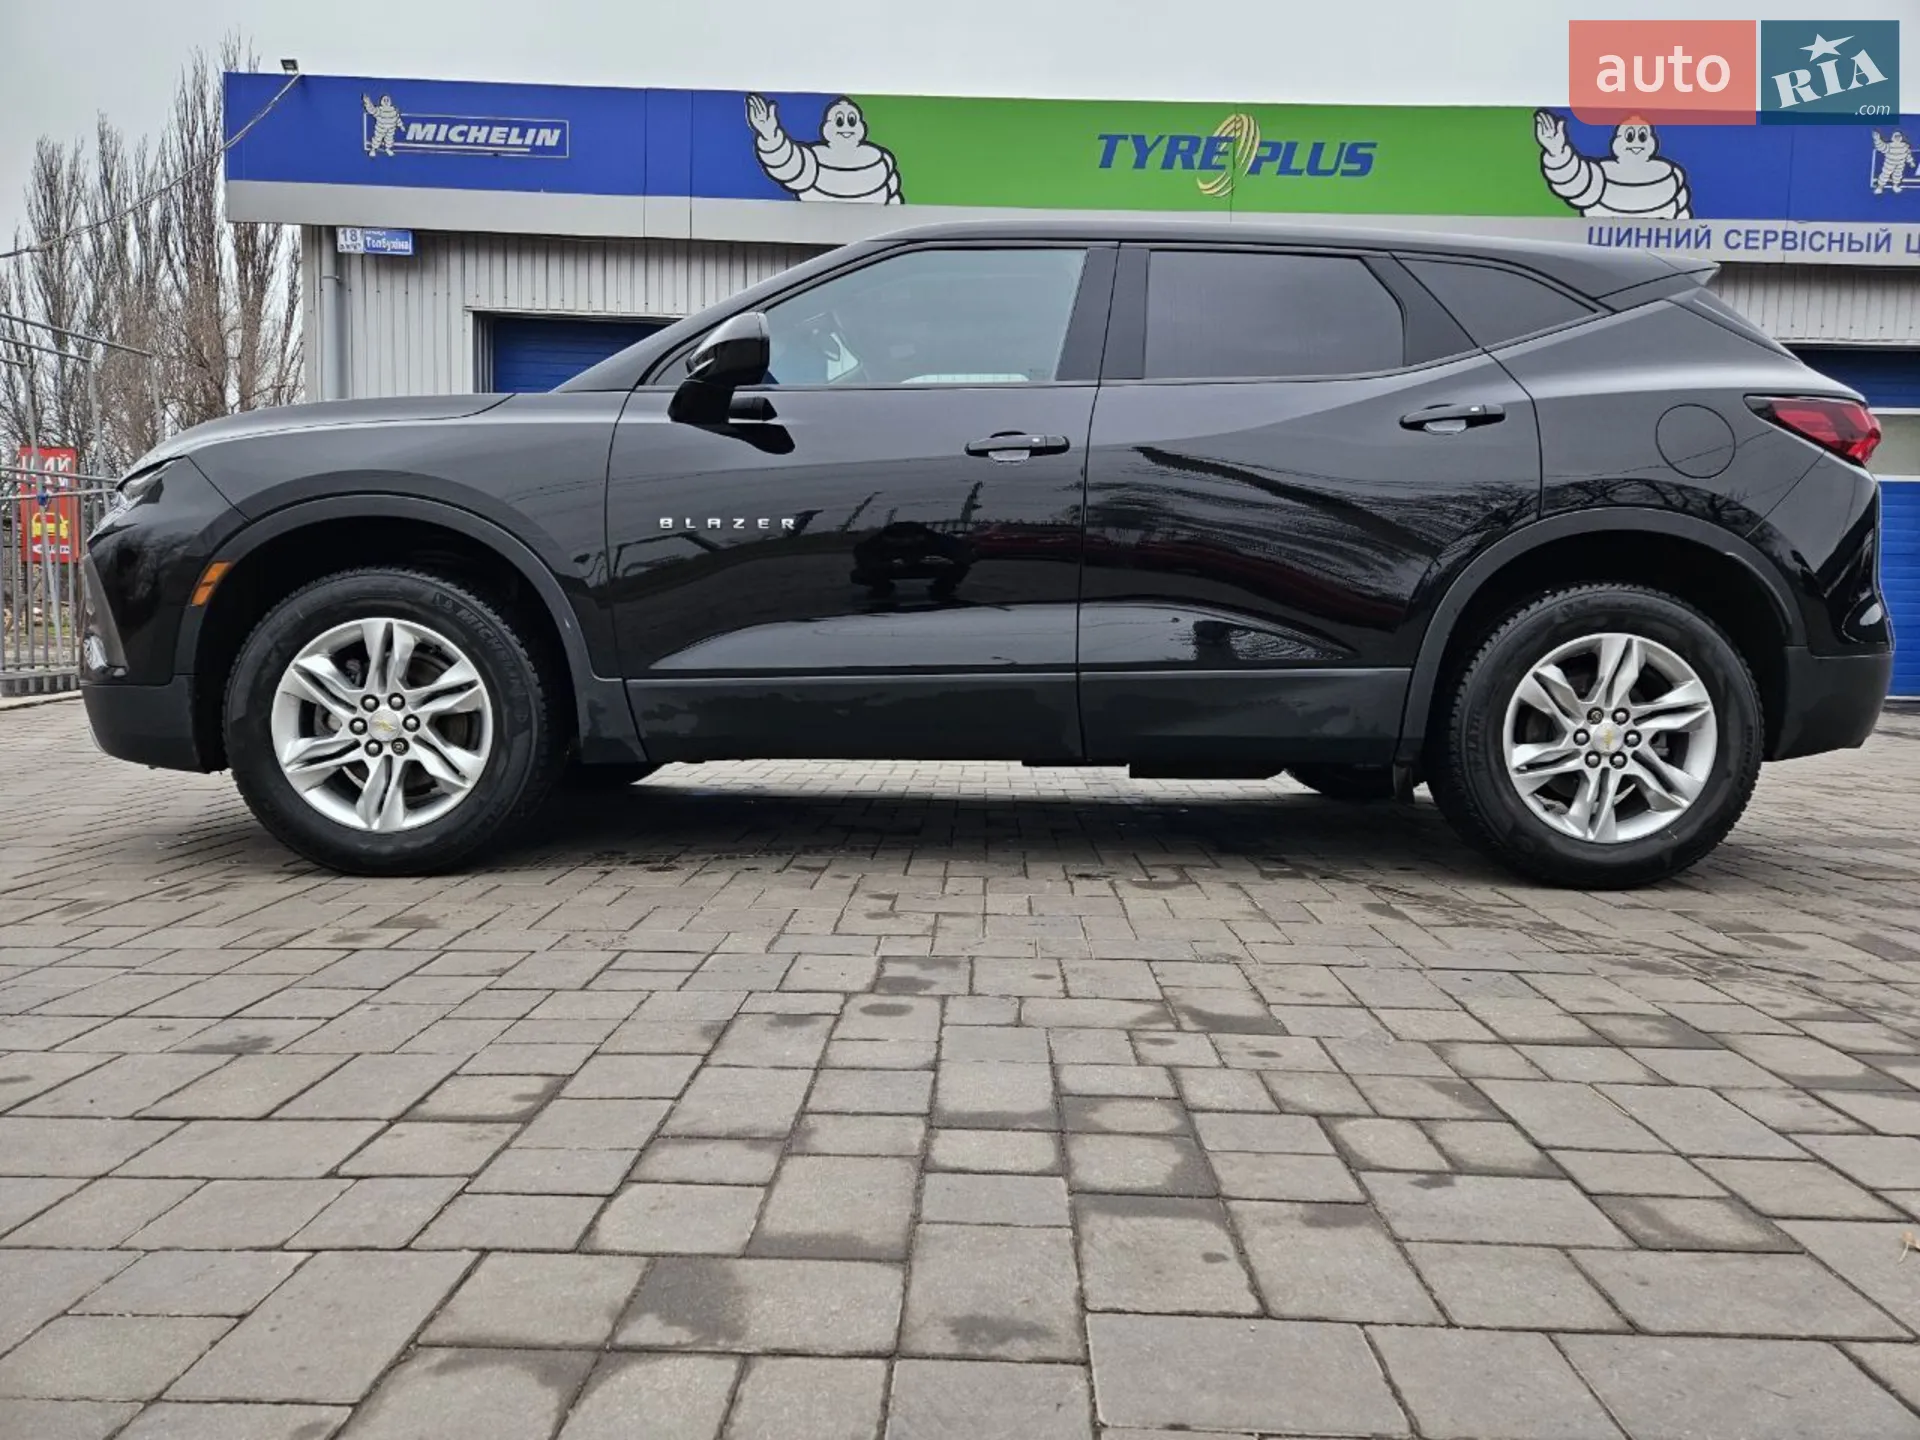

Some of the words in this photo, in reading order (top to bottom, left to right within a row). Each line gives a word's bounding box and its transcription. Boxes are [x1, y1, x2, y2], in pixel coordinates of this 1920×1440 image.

[406, 123, 561, 146] MICHELIN
[1098, 134, 1236, 171] TYRE
[1247, 140, 1377, 177] PLUS
[1587, 224, 1712, 250] ШИННИЙ
[1723, 227, 1892, 253] СЕРВІСНЫЙ
[659, 517, 795, 530] BLAZER
